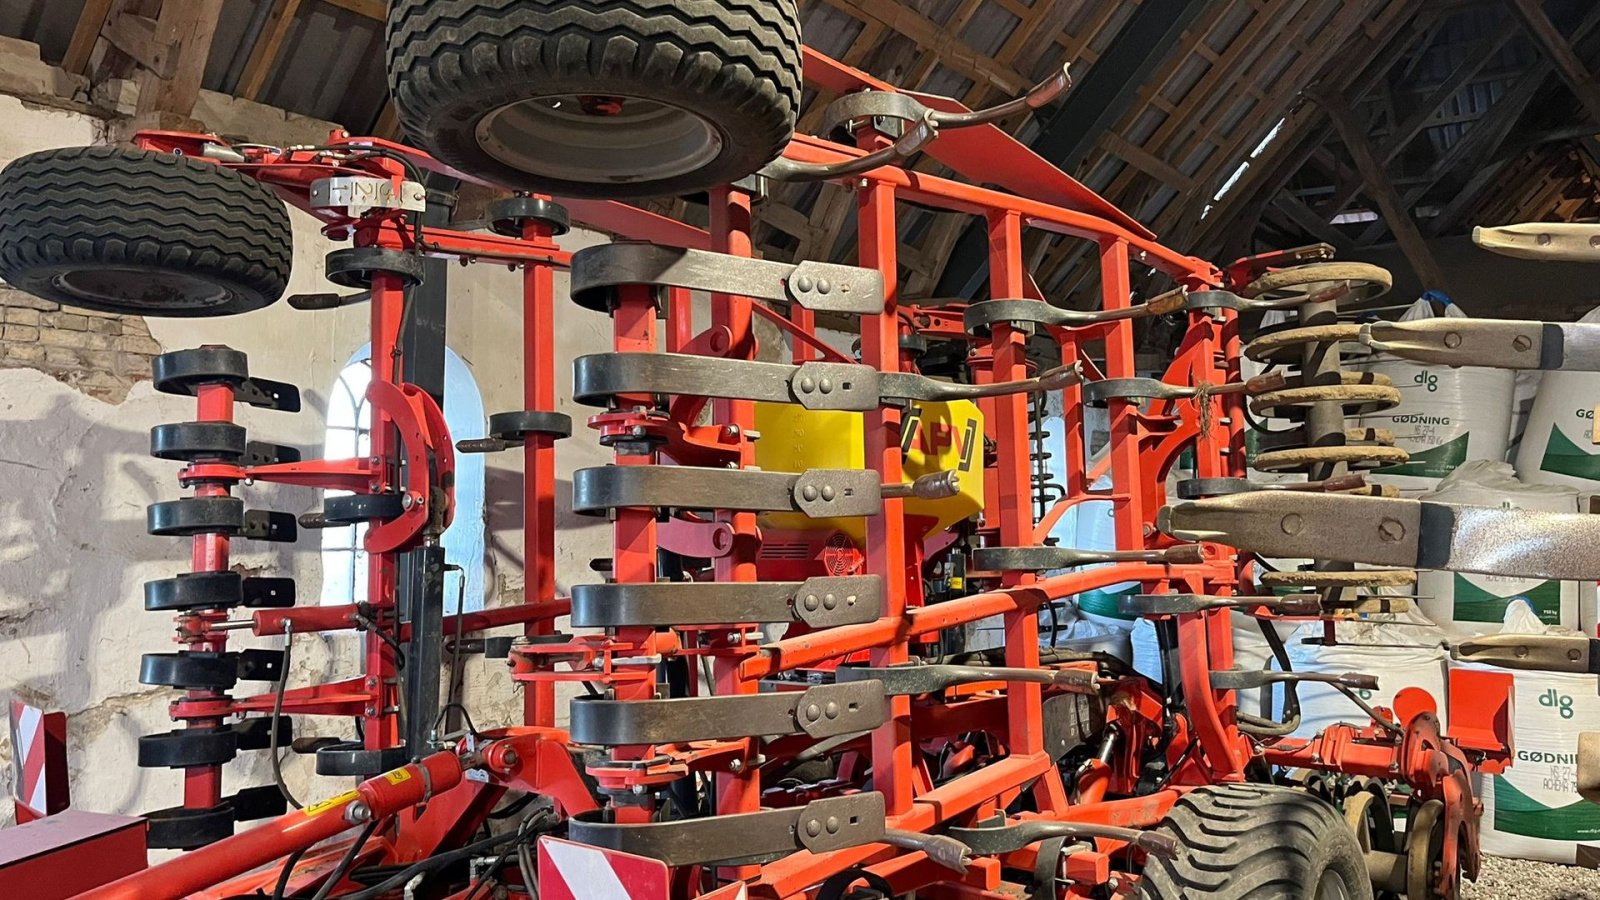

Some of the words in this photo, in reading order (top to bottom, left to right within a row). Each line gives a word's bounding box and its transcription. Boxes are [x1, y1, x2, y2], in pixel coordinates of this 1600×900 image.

[1414, 370, 1438, 392] dlg
[1392, 415, 1450, 426] GØDNING
[1539, 689, 1573, 719] dlg
[1518, 751, 1578, 765] GØDNI
